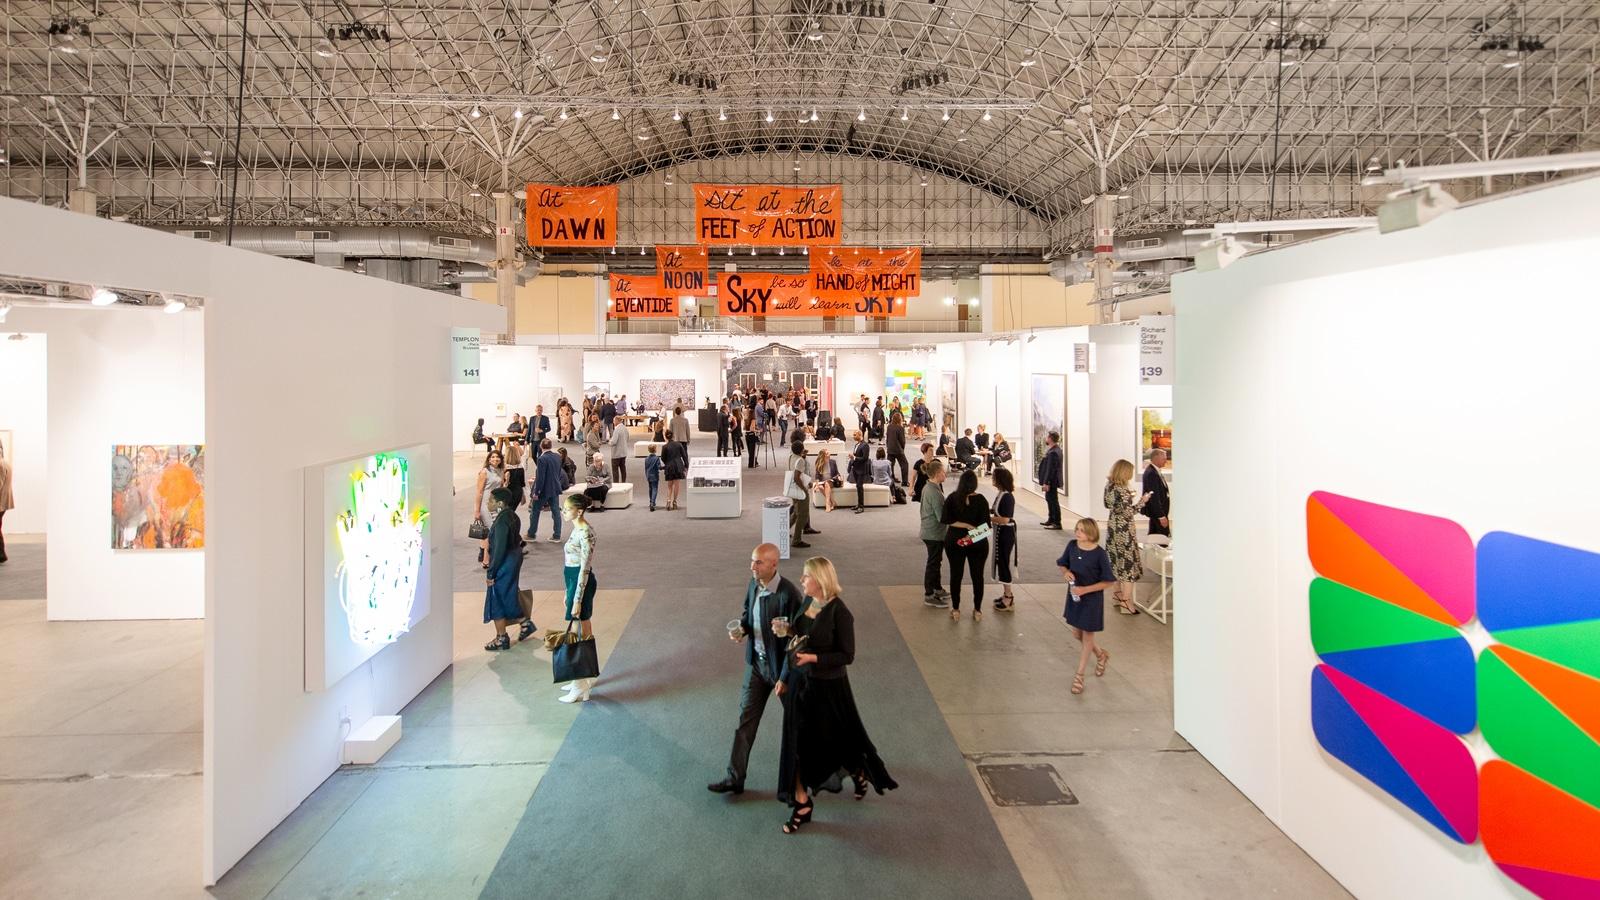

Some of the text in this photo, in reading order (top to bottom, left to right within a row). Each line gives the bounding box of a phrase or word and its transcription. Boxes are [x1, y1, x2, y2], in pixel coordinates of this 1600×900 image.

[756, 190, 780, 211] at
[790, 189, 833, 215] the
[541, 218, 605, 240] DAWN
[702, 217, 836, 239] FEET of ACTION
[828, 256, 908, 267] be at the
[664, 271, 703, 290] NOON
[816, 273, 916, 292] HAND of MIGHT
[727, 275, 807, 313] SKY be so
[774, 297, 801, 310] will
[809, 296, 851, 310] learn
[616, 297, 673, 313] EVENTIDE
[463, 368, 480, 376] 141
[1140, 366, 1163, 376] 139
[780, 510, 788, 530] THE
